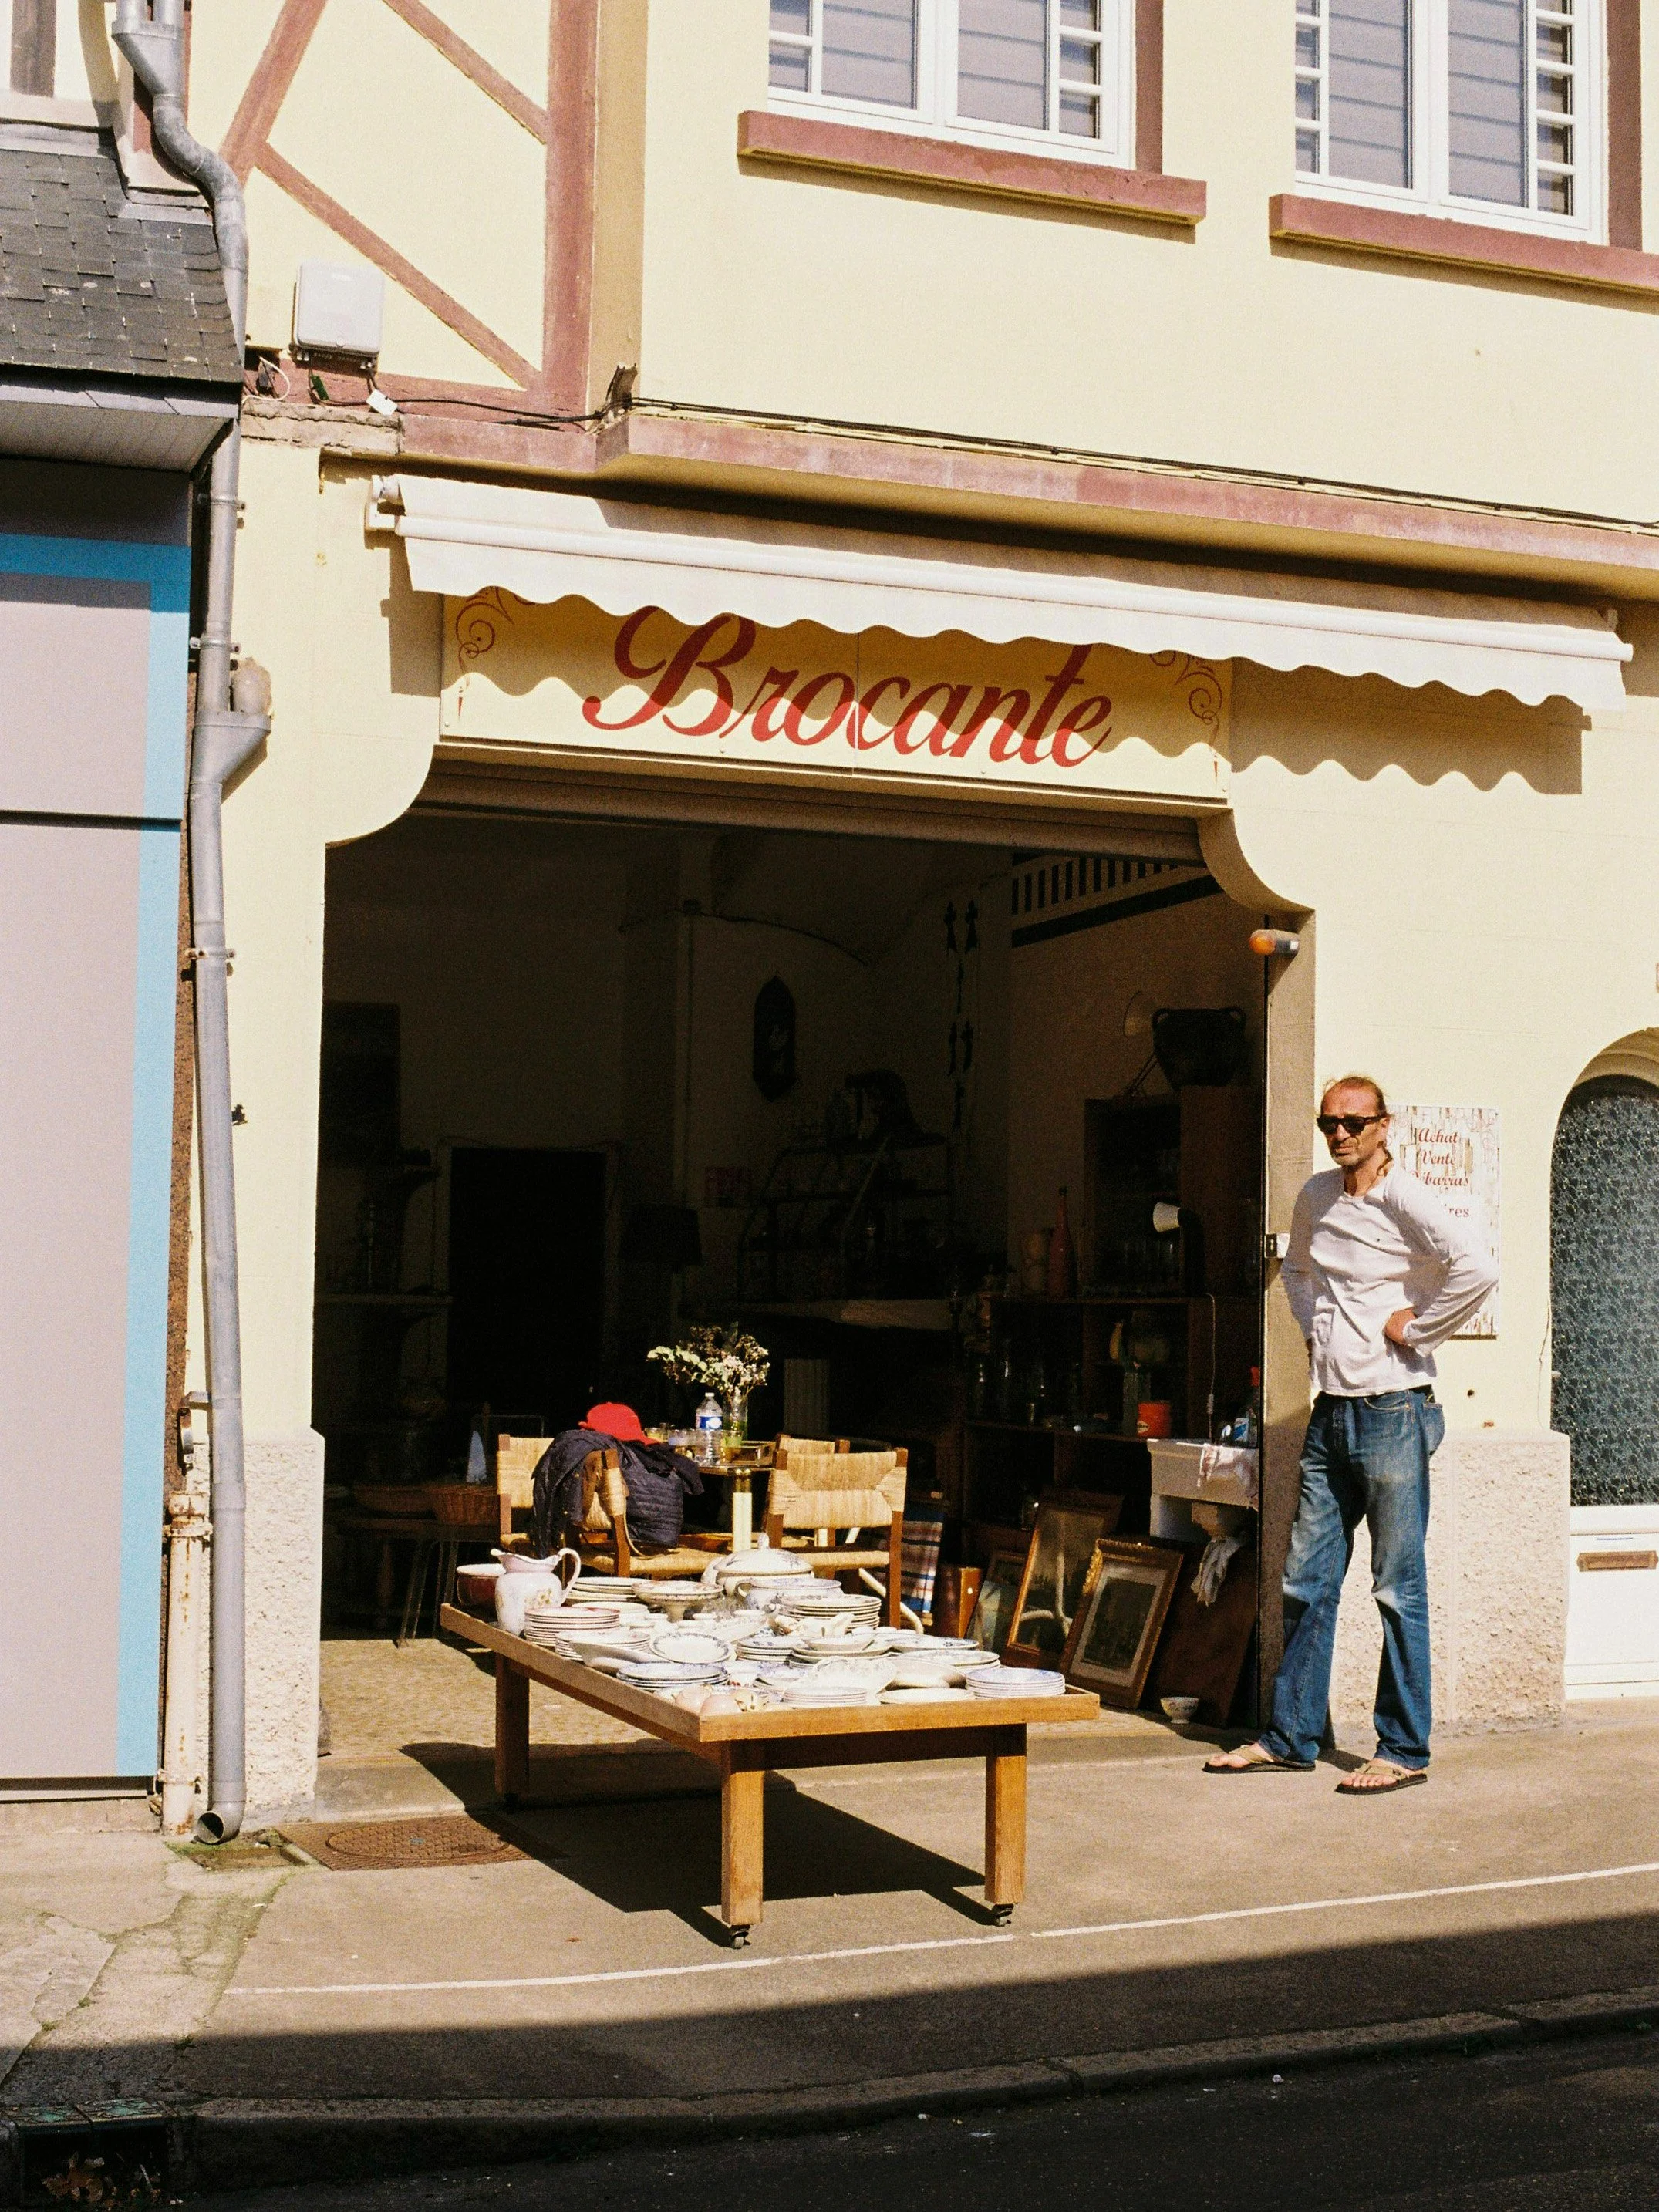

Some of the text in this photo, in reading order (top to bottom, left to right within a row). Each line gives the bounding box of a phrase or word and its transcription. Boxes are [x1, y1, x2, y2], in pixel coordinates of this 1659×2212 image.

[582, 605, 1112, 767] Brocante
[1418, 1128, 1458, 1143] Achat
[1421, 1149, 1456, 1165] Vente
